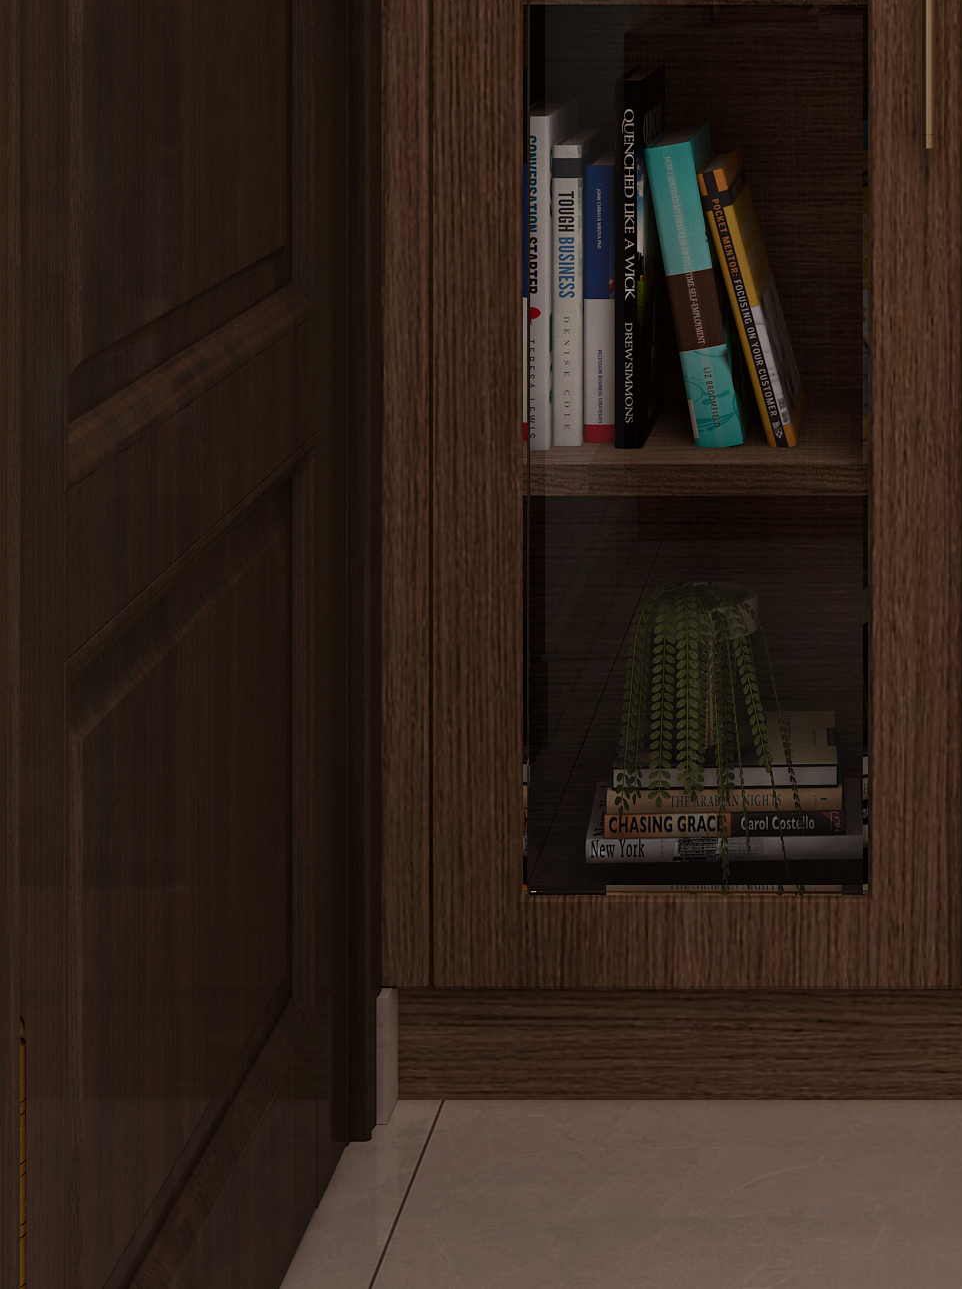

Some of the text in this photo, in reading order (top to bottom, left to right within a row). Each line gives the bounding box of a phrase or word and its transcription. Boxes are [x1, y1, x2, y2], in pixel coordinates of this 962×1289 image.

[558, 191, 575, 298] TOUGH BUSINESS
[621, 108, 635, 301] QUENCHED LIKE A WICK
[668, 176, 678, 204] SURVIVED
[690, 287, 705, 345] SELF-EMPLOYMENT
[711, 198, 778, 416] POCKET MENTOR: FOCUSING ON YOUR CUSTOMER
[624, 322, 634, 424] DREW SIMMONS
[703, 367, 721, 428] LIZ BROOMFIELD
[608, 815, 724, 833] CHASING GRACE
[670, 795, 690, 808] THE
[742, 794, 782, 806] NIGHTS
[740, 816, 816, 830] Carol Costello
[590, 839, 616, 858] New
[618, 838, 645, 858] York
